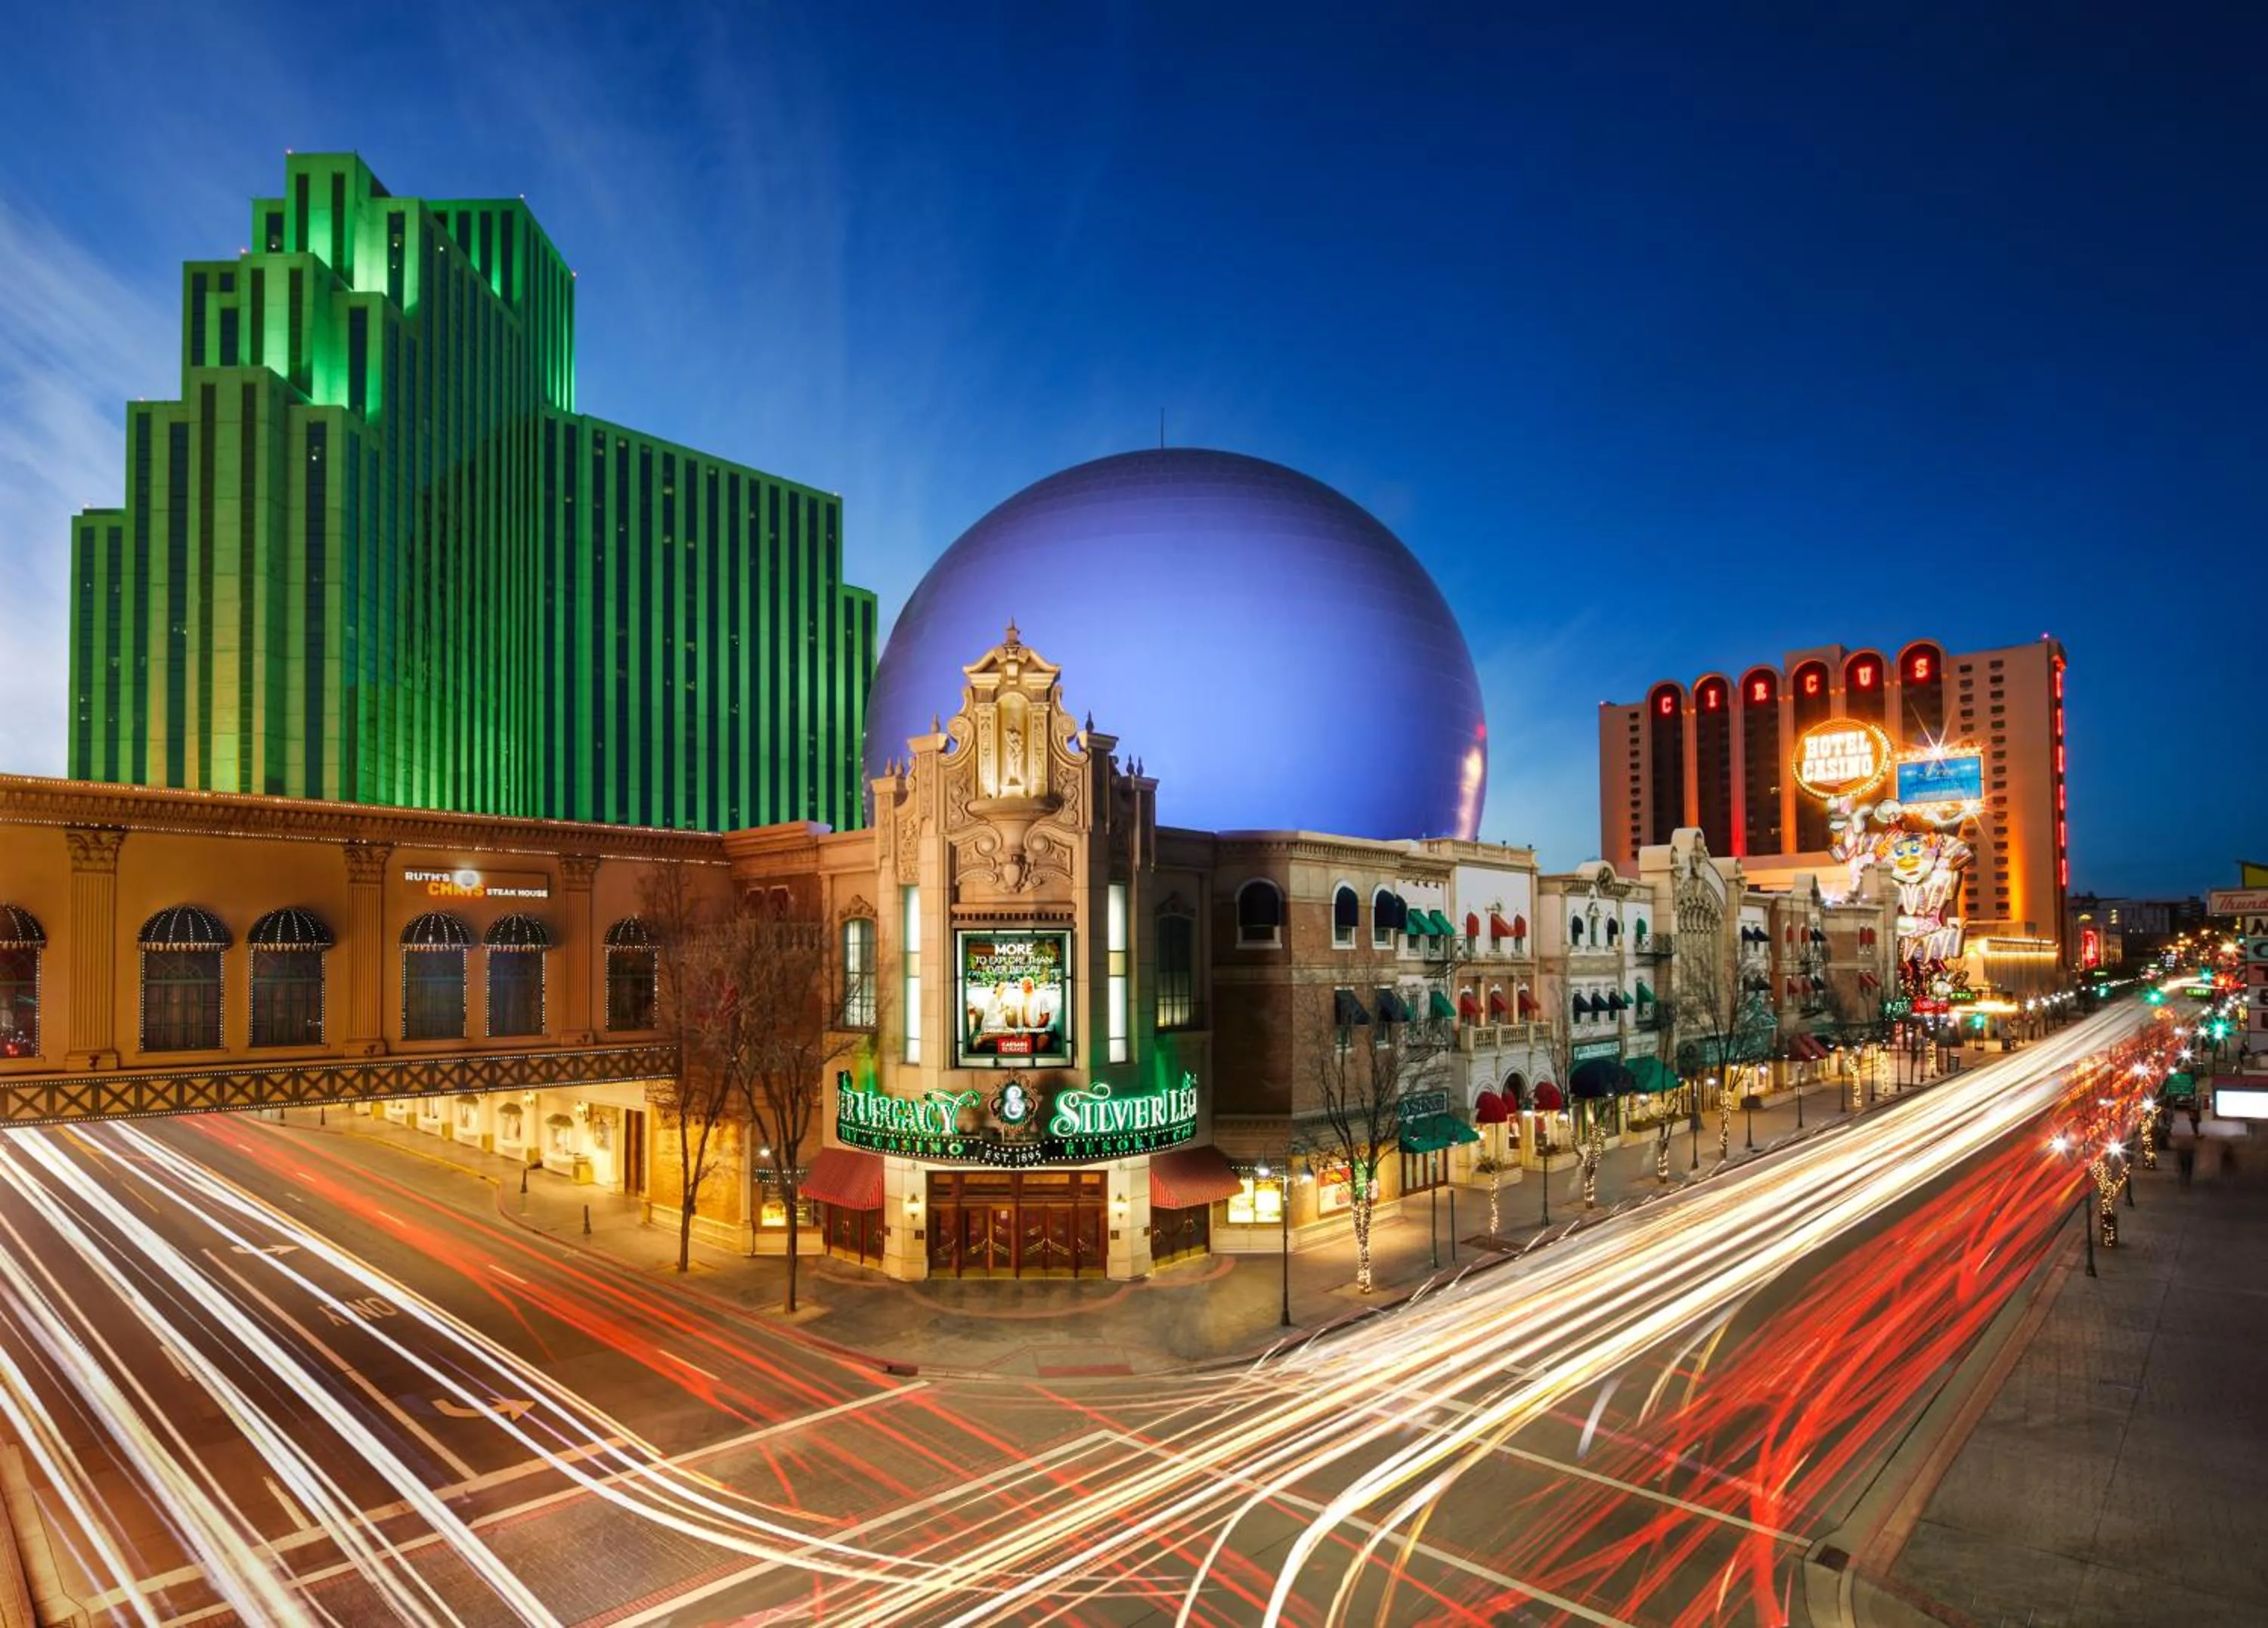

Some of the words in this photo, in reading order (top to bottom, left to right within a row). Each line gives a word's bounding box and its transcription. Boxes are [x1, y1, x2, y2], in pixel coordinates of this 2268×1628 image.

[1661, 658, 1928, 714] CIRCUS
[1805, 730, 1871, 757] HOTEL
[1802, 756, 1873, 784] CASINO
[404, 871, 451, 881] RUTH'S
[518, 890, 548, 898] HOUSE
[976, 956, 987, 965] TO
[994, 943, 1033, 955] MORE
[856, 1089, 981, 1135] LEGACY
[1051, 1083, 1167, 1137] SILVER
[872, 1135, 965, 1156] CASINO
[985, 1150, 1011, 1163] EST.
[1016, 1150, 1041, 1163] 1895
[318, 1297, 398, 1326] ONY
